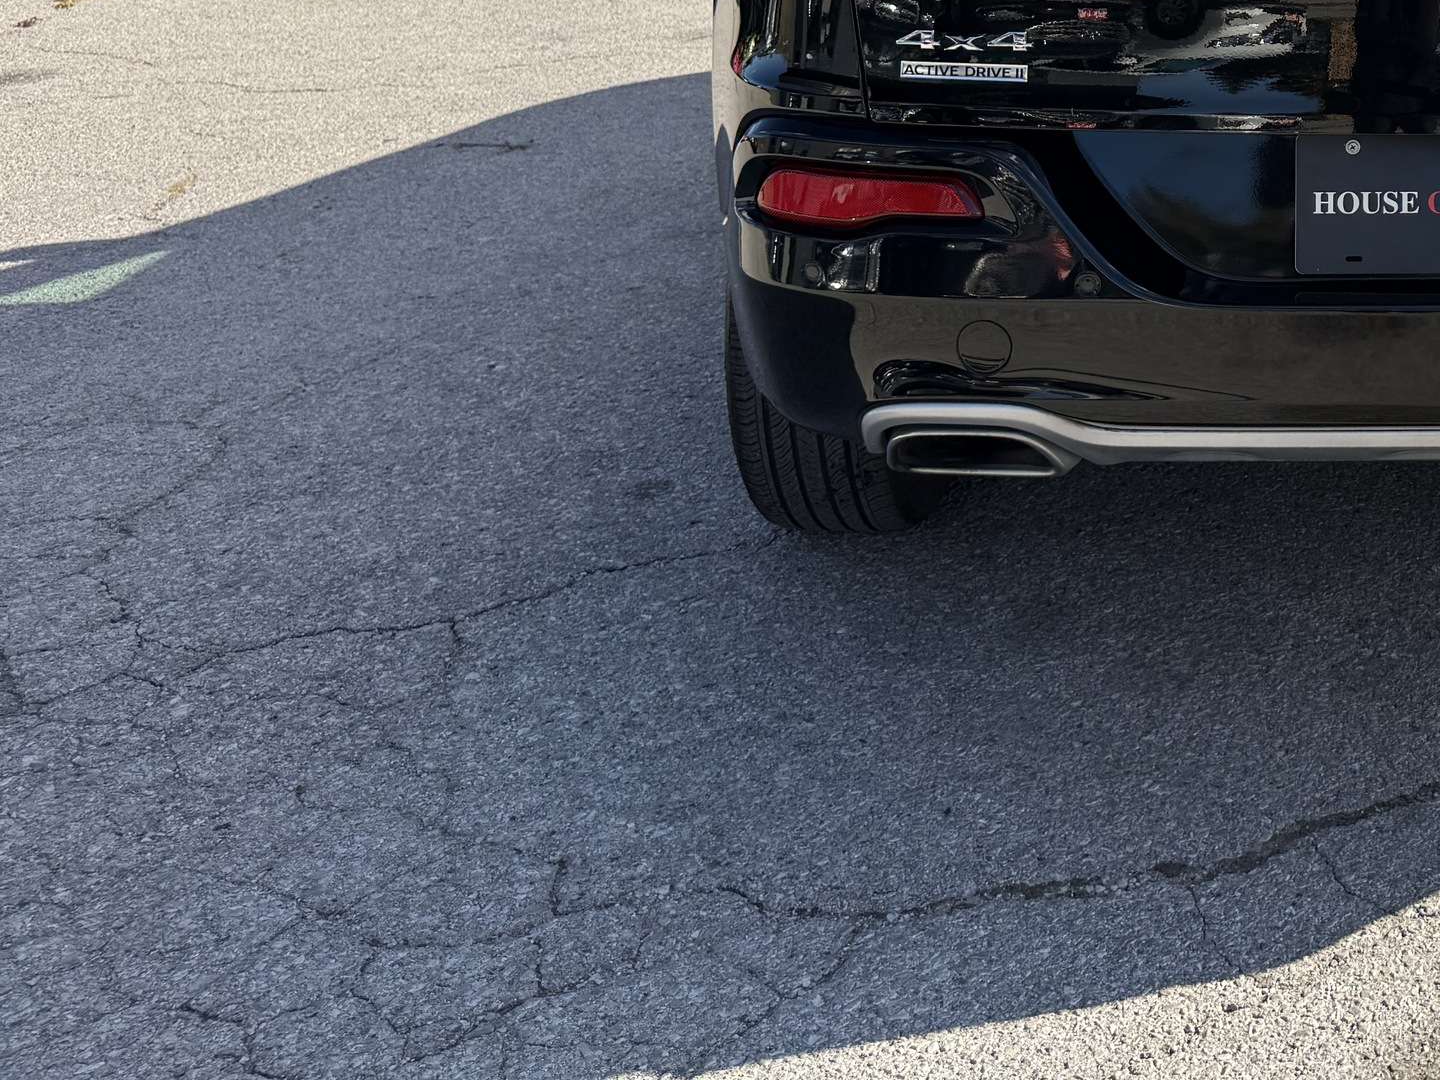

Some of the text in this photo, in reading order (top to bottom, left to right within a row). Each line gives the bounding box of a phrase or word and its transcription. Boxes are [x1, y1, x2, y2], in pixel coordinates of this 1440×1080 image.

[903, 64, 1025, 79] ACTIVE DRIVE II
[1312, 191, 1420, 214] HOUSE
